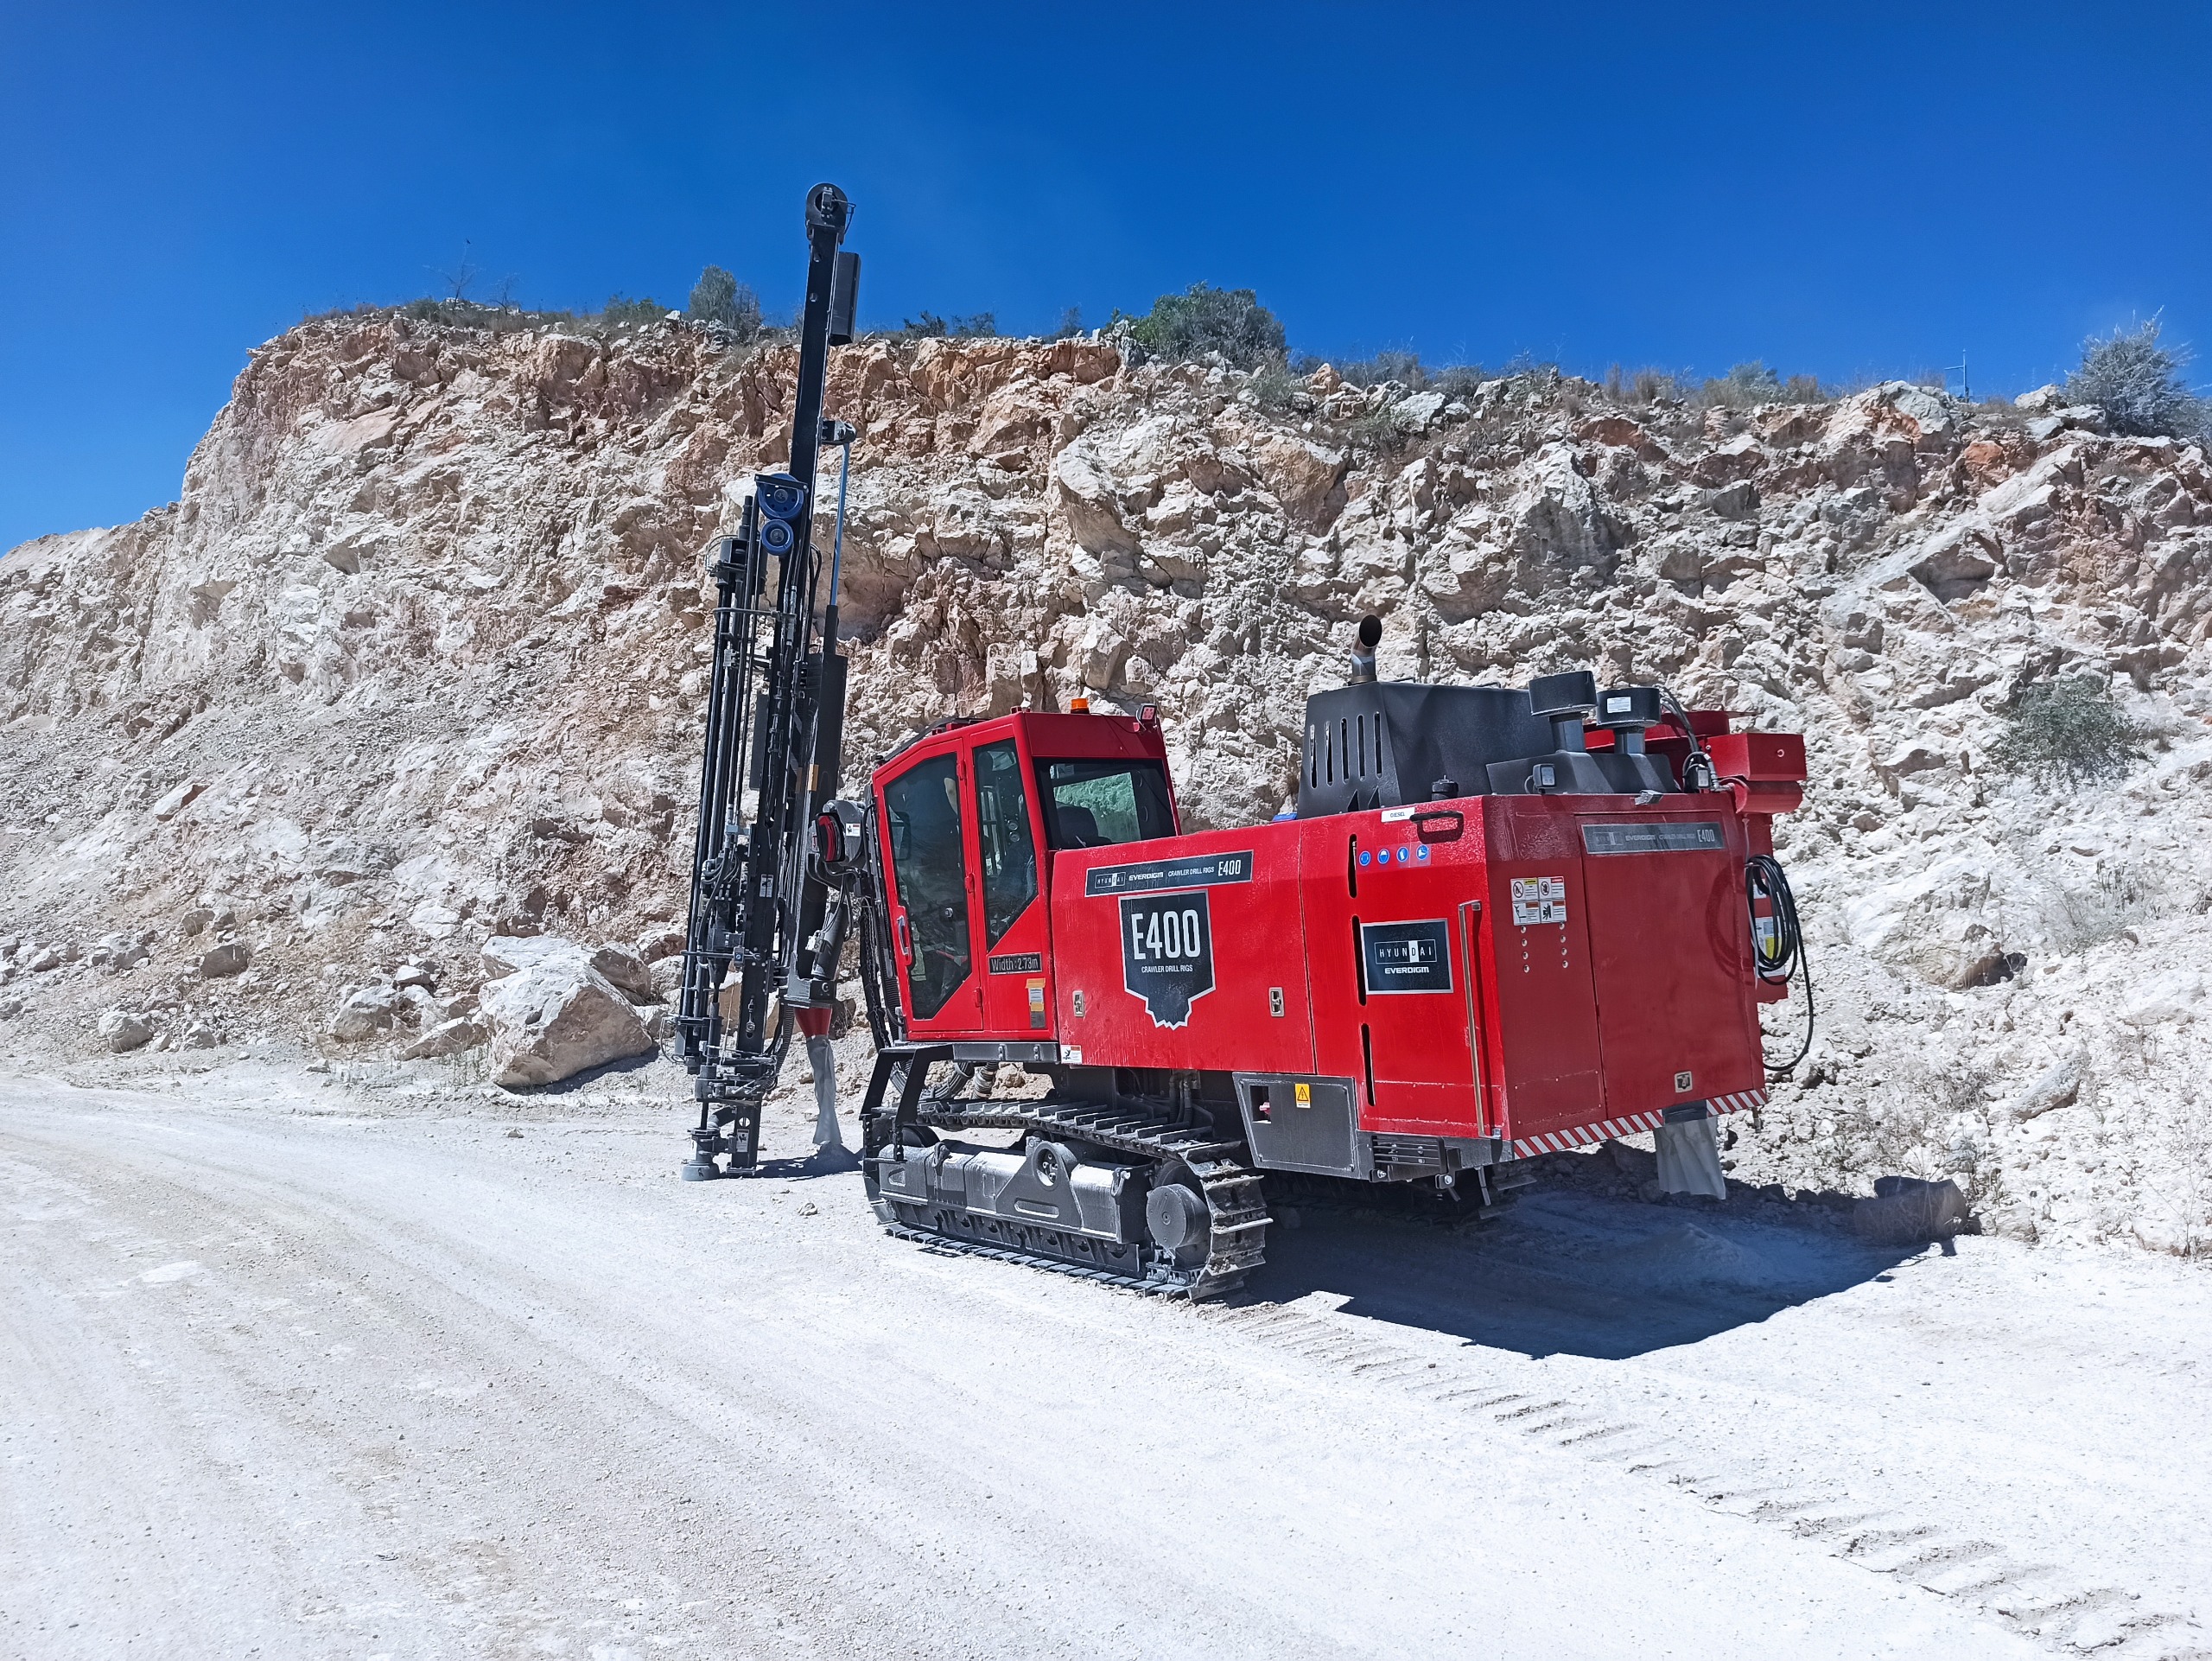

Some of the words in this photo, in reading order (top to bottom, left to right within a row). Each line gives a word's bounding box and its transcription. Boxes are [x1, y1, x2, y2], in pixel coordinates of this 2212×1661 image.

[1696, 829, 1715, 843] E400
[1128, 871, 1164, 881] EVERDIGM
[1217, 859, 1242, 876] E400
[1131, 909, 1201, 960] E400
[1378, 945, 1433, 958] HYUNDAI
[1180, 964, 1193, 972] RIGS
